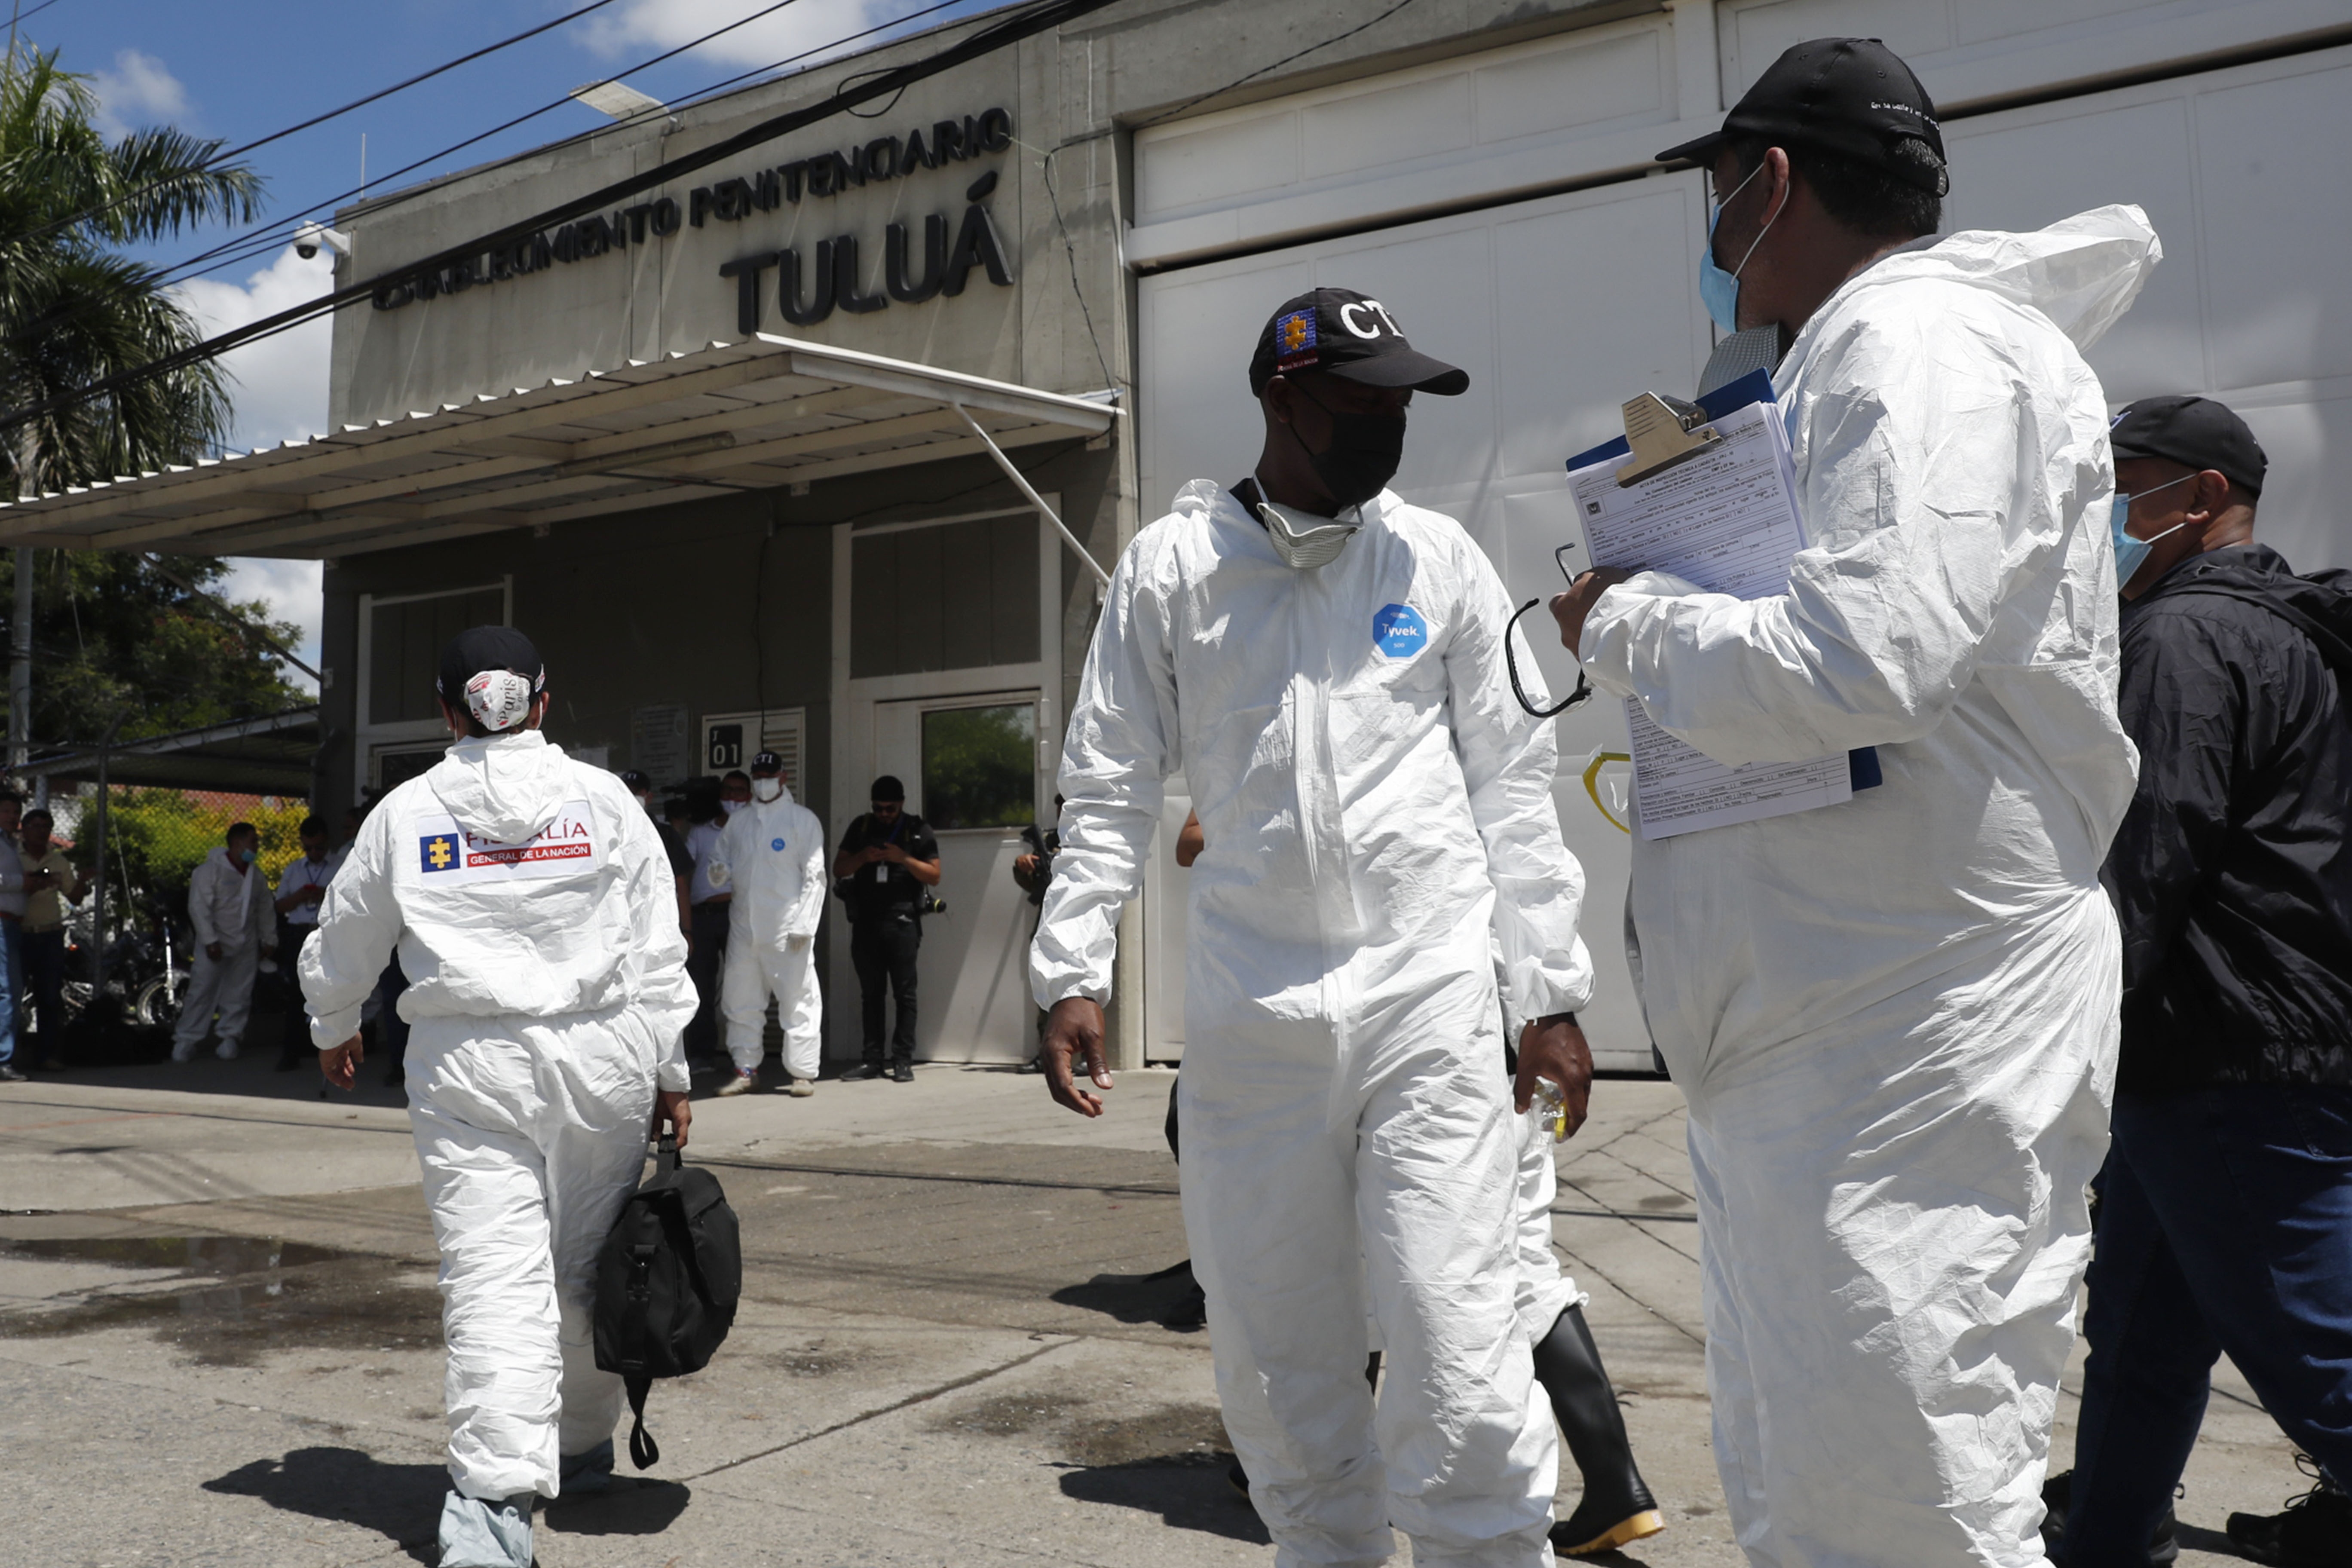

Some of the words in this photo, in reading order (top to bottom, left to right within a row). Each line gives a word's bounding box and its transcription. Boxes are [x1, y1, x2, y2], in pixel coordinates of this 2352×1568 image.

[689, 107, 1012, 228] PENITENCIARIO
[719, 170, 1014, 335] TULUÁ
[1382, 623, 1418, 637] Tyvek
[496, 678, 516, 723] Paris
[713, 744, 738, 765] 01
[753, 754, 773, 765] CTI
[470, 852, 518, 864] GENERAL
[520, 851, 533, 859] DE
[536, 849, 549, 858] LA
[550, 845, 588, 857] NACIÓN
